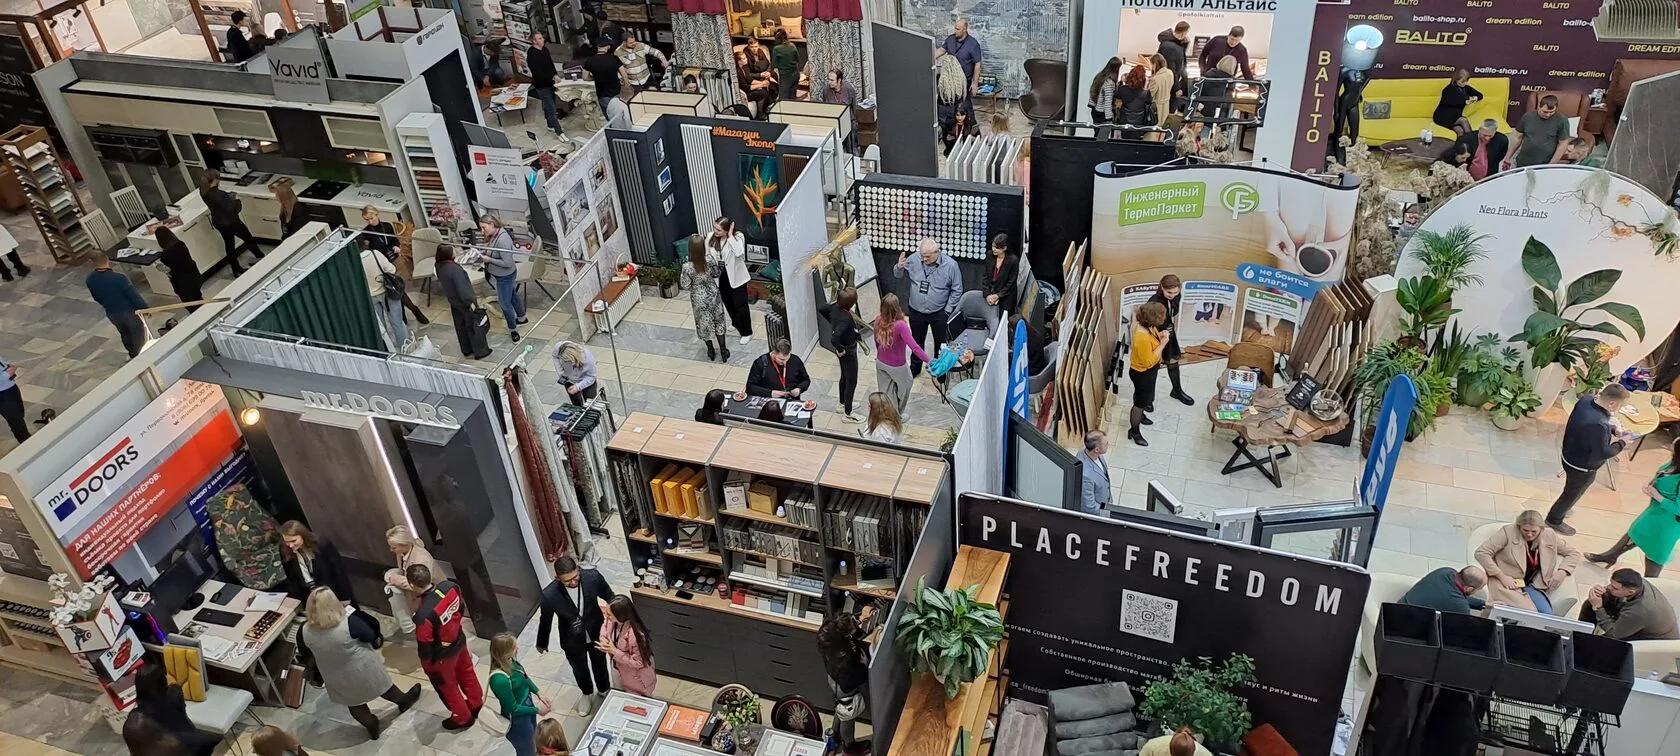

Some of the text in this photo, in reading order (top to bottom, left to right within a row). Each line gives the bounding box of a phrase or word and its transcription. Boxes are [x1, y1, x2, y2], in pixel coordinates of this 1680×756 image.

[1467, 0, 1493, 8] BALITO
[1543, 2, 1570, 10] BALITO
[1367, 13, 1394, 21] edition
[1412, 14, 1467, 24] balito-shop.ru
[1485, 17, 1543, 26] dream edition
[1533, 44, 1560, 52] BALITO
[1627, 43, 1661, 53] DREAM
[1402, 63, 1428, 71] dream
[1474, 66, 1529, 76] balito-shop.ru
[1548, 70, 1606, 79] dream edition
[1306, 50, 1332, 143] BALITO
[1125, 185, 1200, 204] Инженерный
[1124, 202, 1198, 220] ТермоПаркет
[1479, 204, 1549, 219] Neo Flora Plants
[1258, 268, 1310, 288] не боится
[1258, 276, 1288, 289] влаги
[73, 445, 139, 505] DOORS
[47, 488, 69, 508] mr.
[74, 533, 91, 552] ДЛЯ
[91, 508, 120, 537] НАШИХ
[981, 515, 1343, 616] PLACEFREEDOM
[1032, 628, 1069, 643] создавать
[1070, 638, 1115, 653] уникальное
[1269, 685, 1290, 697] ритм
[1291, 692, 1318, 703] жизни
[1040, 646, 1087, 664] Собственное
[1087, 657, 1139, 677] производство
[1064, 668, 1103, 684] Обширная
